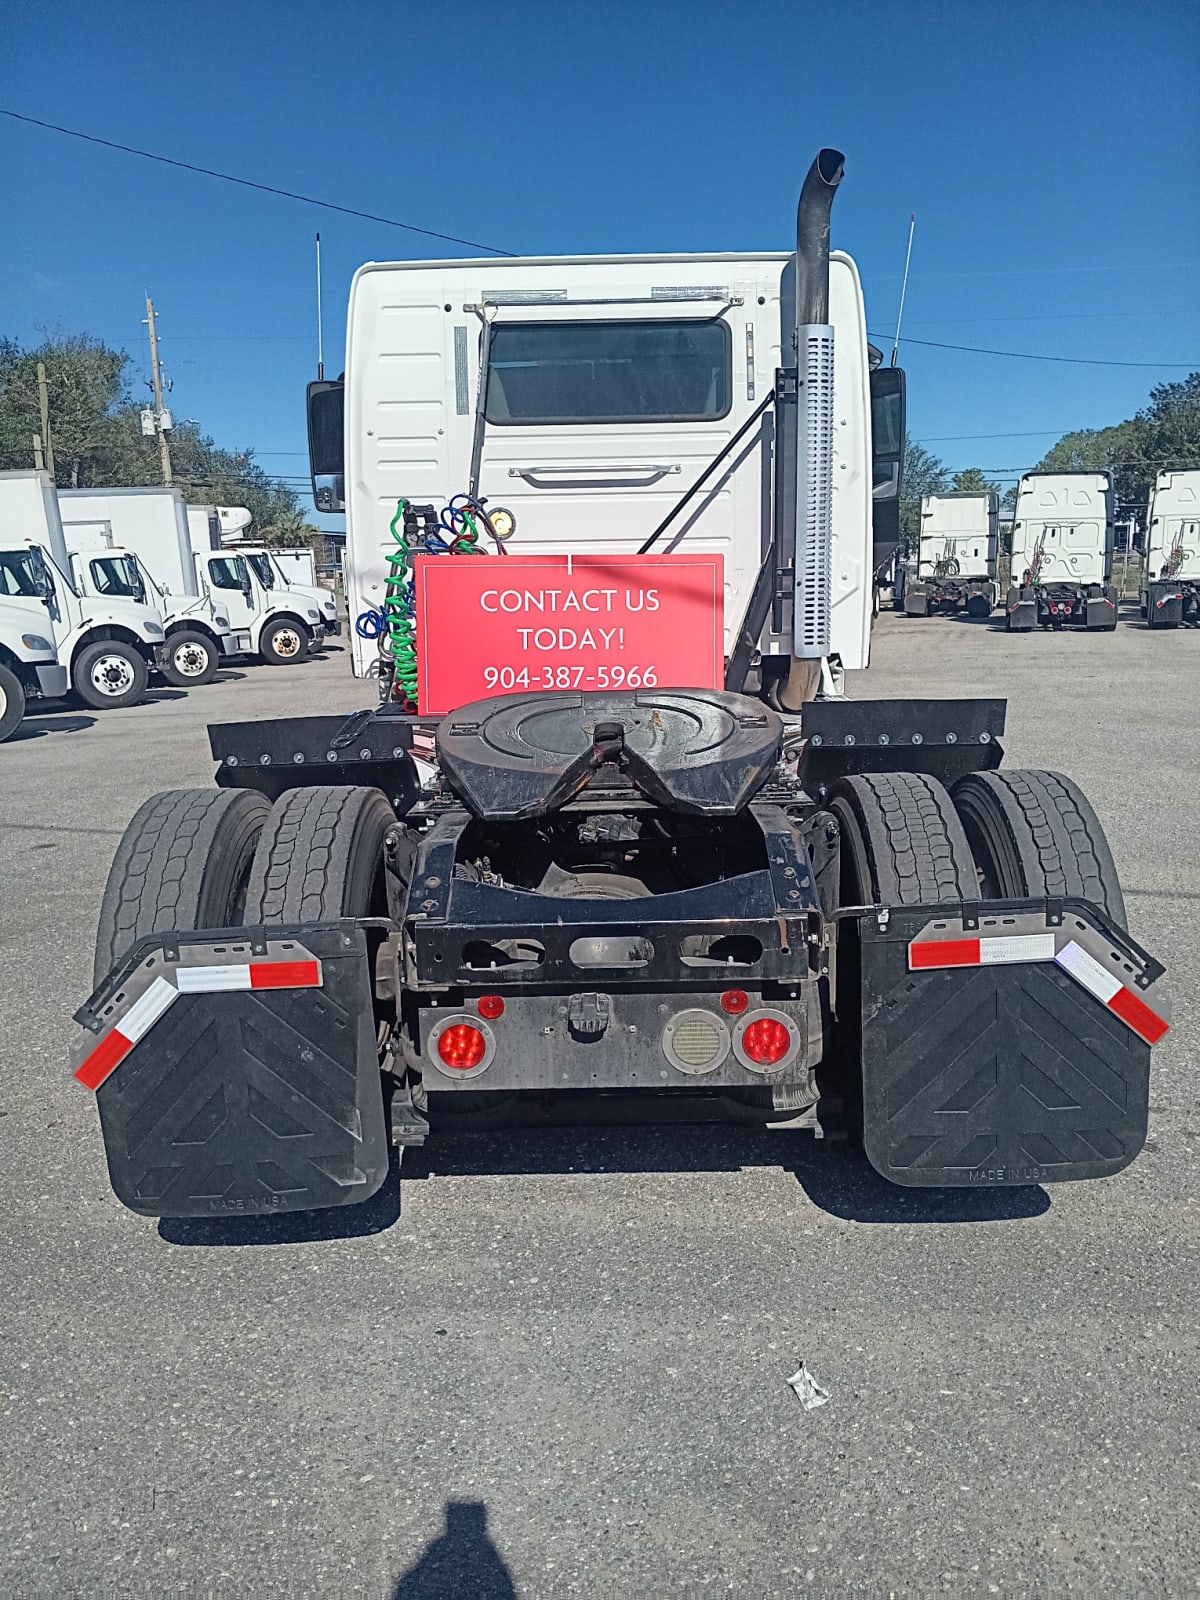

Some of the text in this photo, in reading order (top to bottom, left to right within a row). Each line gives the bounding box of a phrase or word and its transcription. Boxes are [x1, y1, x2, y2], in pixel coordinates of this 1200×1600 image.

[479, 588, 660, 613] CONTACT US
[516, 627, 626, 651] TODAY!
[483, 665, 658, 690] 904-387-5966
[968, 1167, 1049, 1181] MADE IN USA
[209, 1199, 245, 1211] MADE
[262, 1195, 289, 1208] USA
